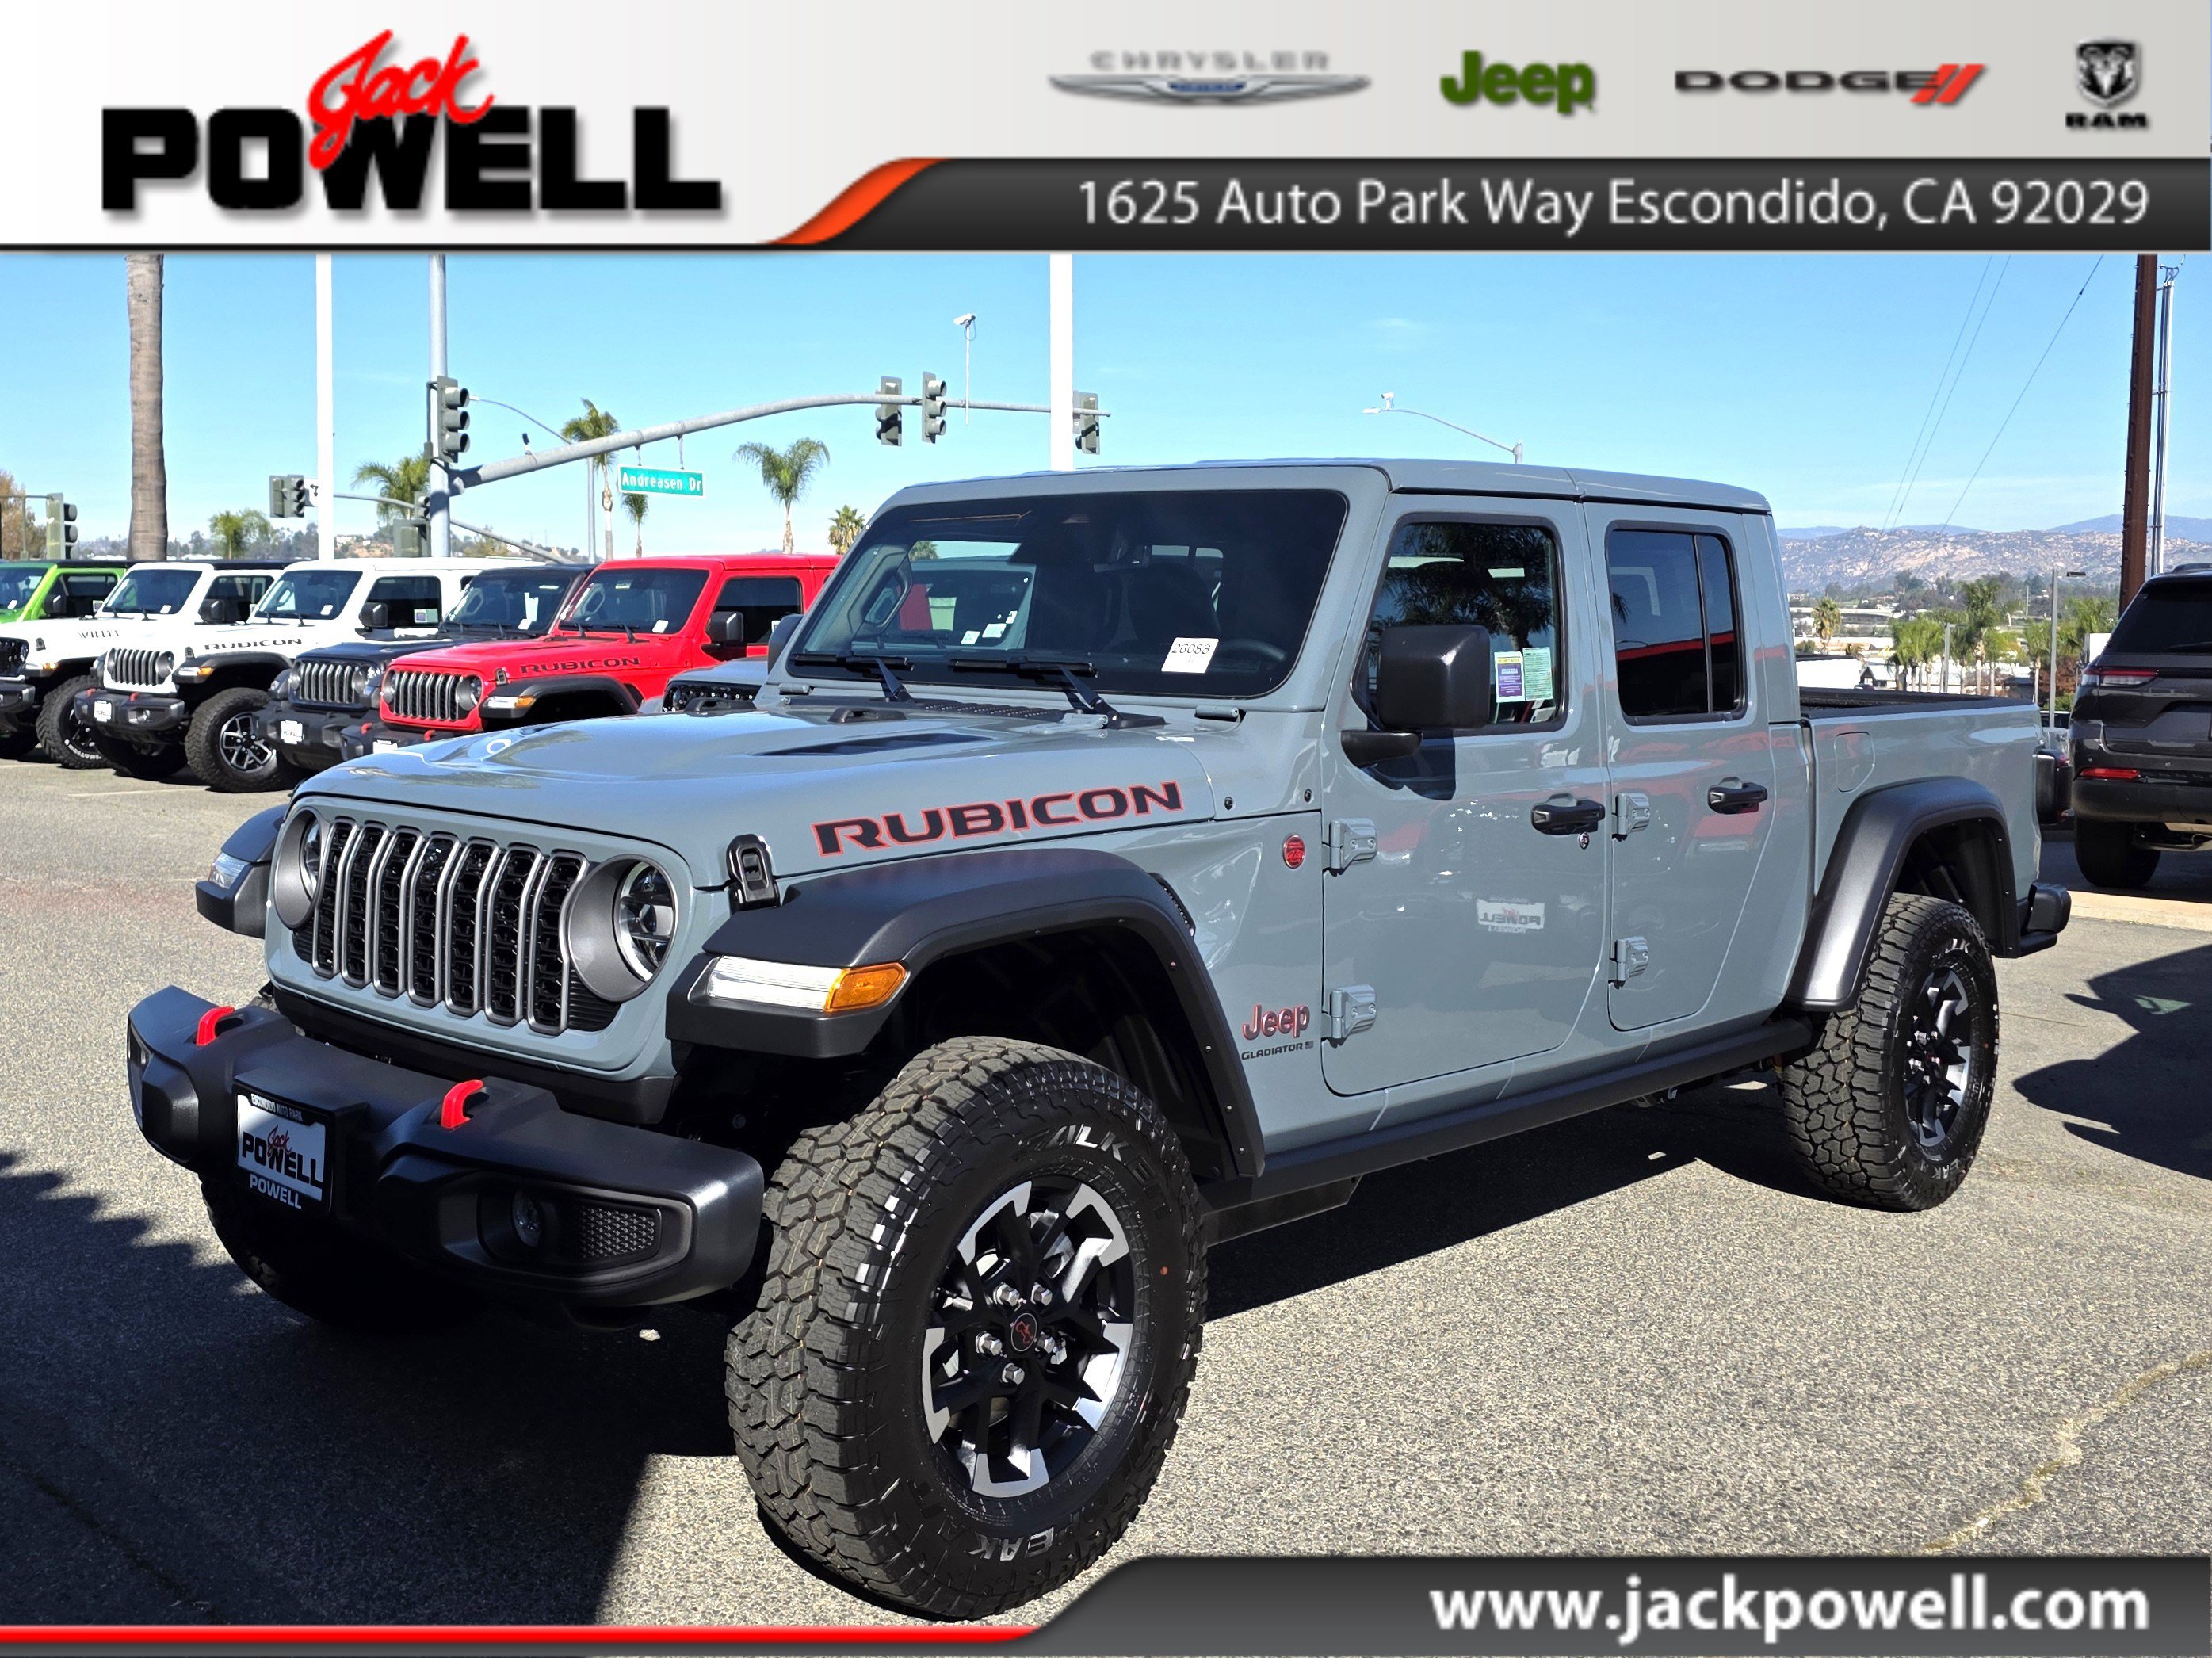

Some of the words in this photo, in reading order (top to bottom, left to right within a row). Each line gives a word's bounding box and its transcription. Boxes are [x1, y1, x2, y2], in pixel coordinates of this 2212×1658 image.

[622, 472, 683, 490] Andreasen
[689, 476, 701, 491] Dr
[204, 638, 302, 650] RUBICON
[520, 657, 640, 674] RUBICON
[812, 780, 1184, 858] RUBICON
[1242, 1003, 1310, 1041] Jeep
[1241, 1042, 1304, 1060] GLADIATOR
[242, 1131, 324, 1187] POWELL
[267, 1124, 292, 1159] Jack
[249, 1174, 302, 1210] POWELL
